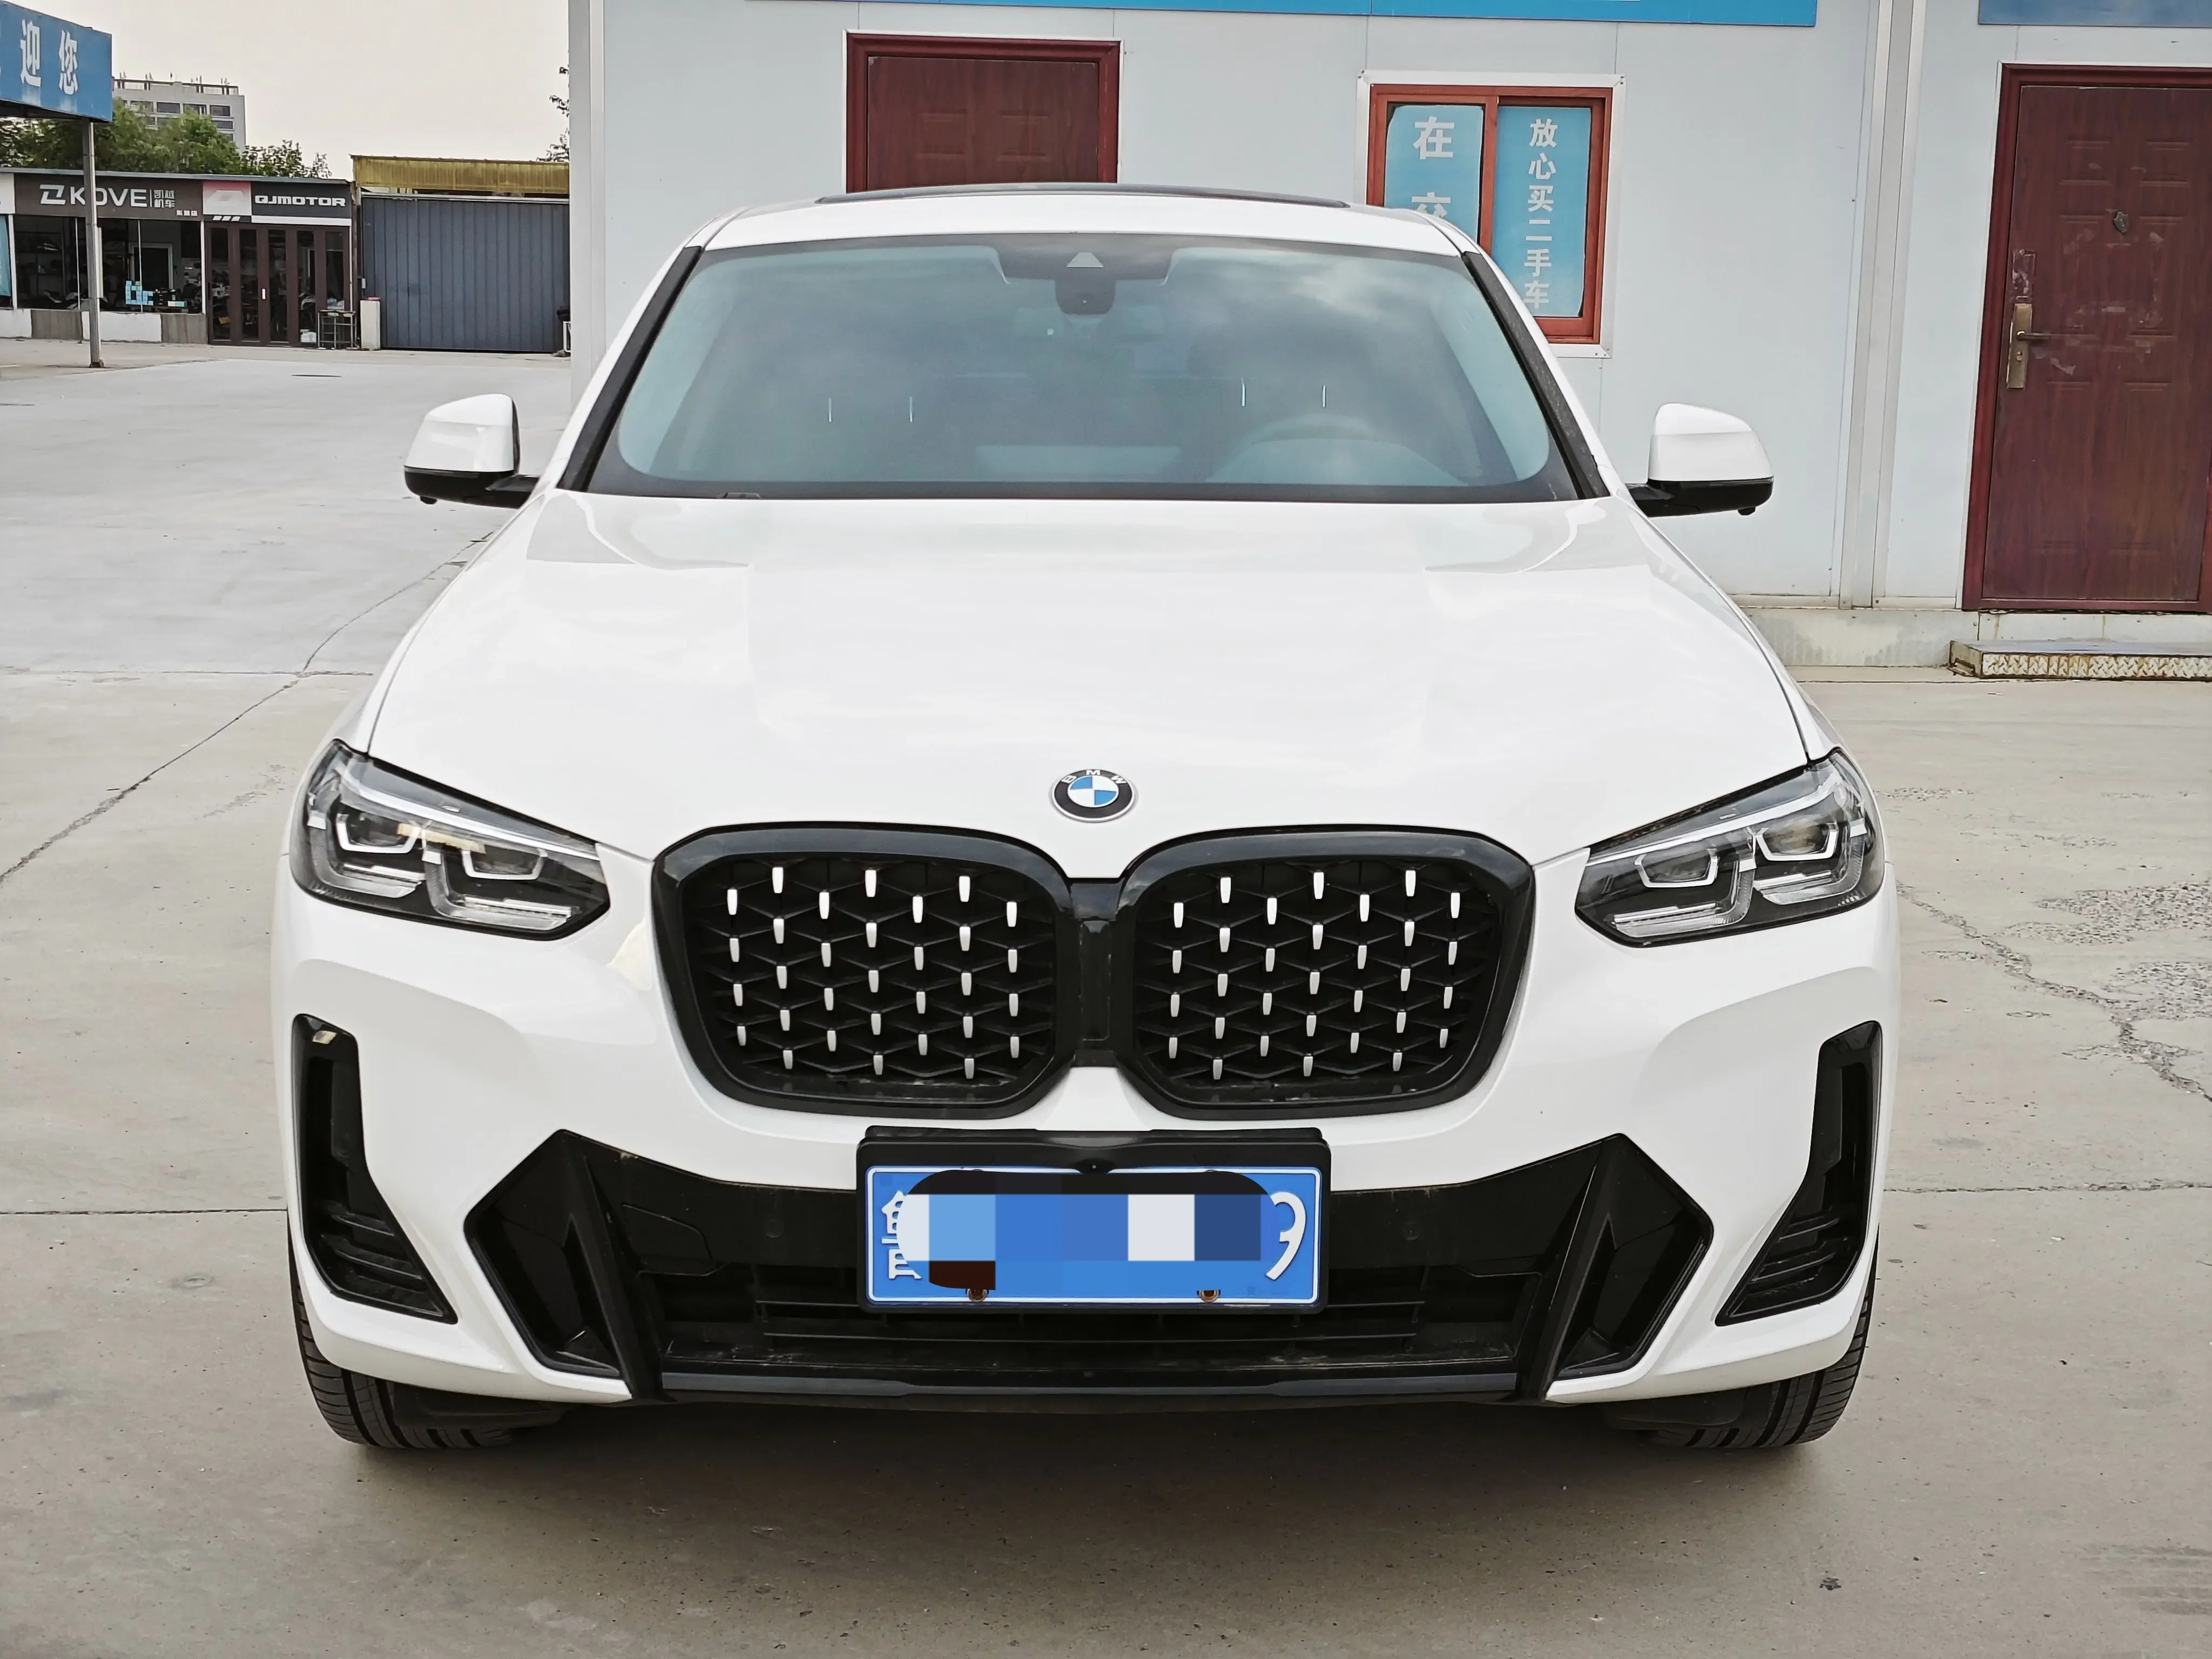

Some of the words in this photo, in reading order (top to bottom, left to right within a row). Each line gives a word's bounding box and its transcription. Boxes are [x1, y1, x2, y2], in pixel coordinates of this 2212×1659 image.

[0, 19, 78, 95] 迎您
[254, 195, 346, 207] QJMOTOR
[1522, 118, 1558, 309] 放心买二手车
[1061, 769, 1127, 784] BMW
